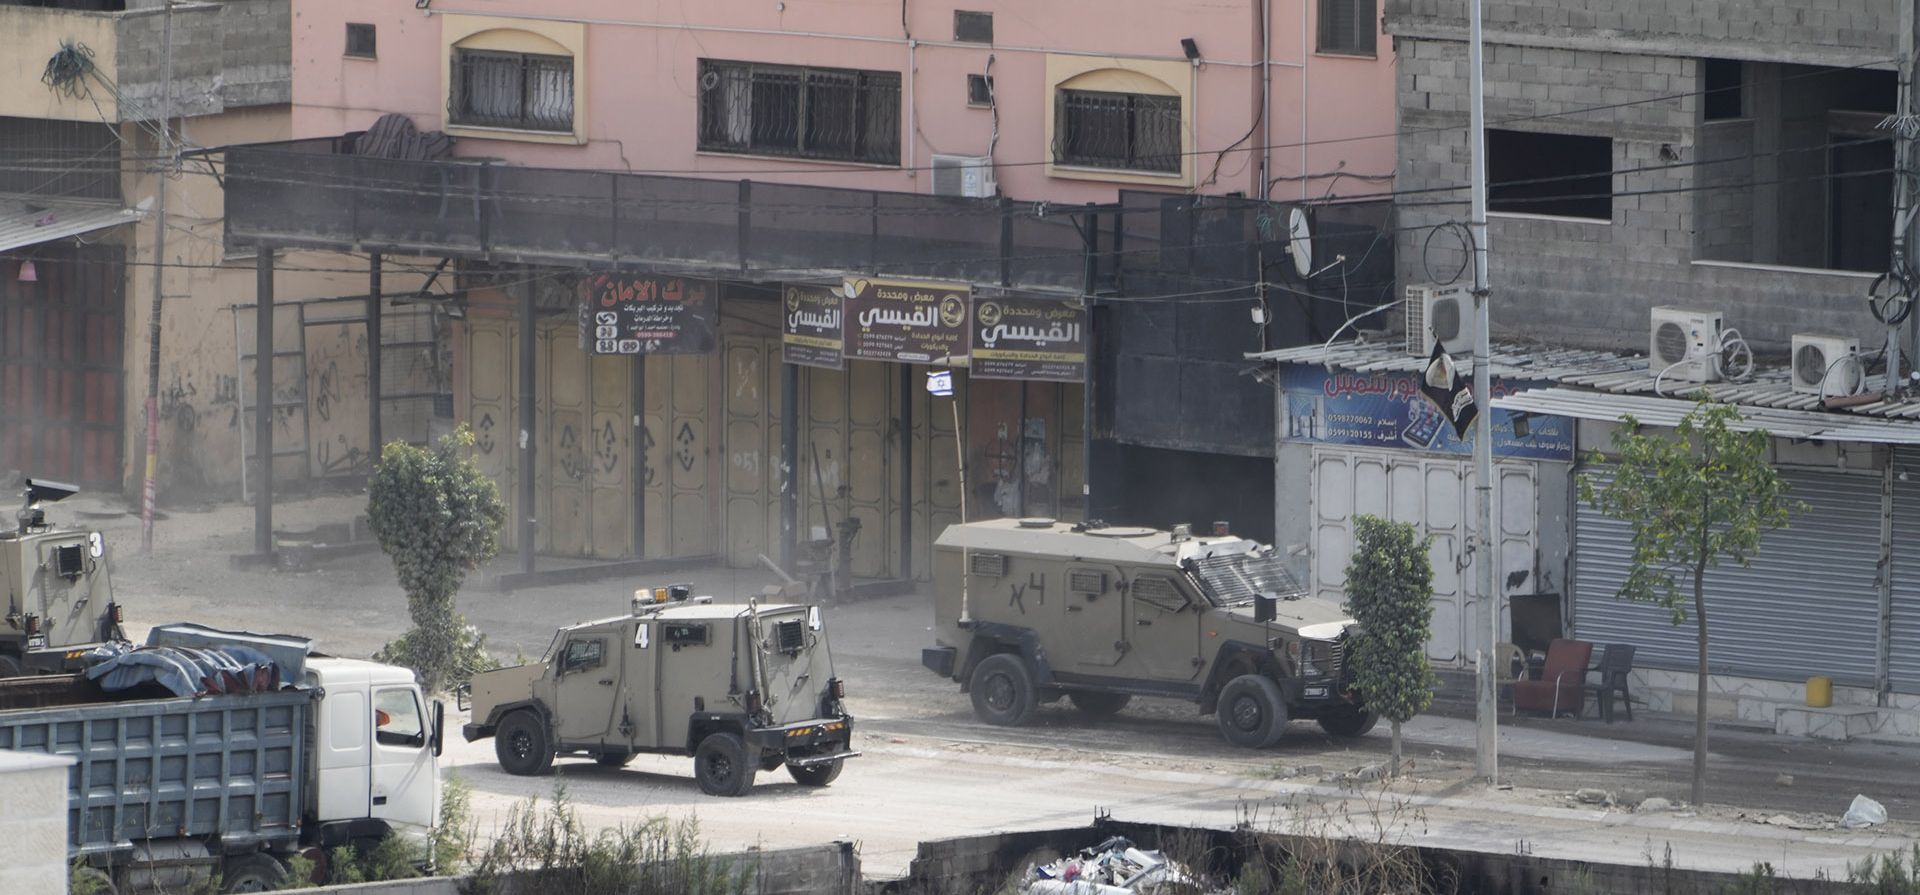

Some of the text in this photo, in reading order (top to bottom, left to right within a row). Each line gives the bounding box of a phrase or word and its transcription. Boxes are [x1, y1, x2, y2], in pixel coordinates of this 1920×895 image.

[600, 279, 657, 306] الامان
[877, 289, 935, 303] معرض ومحددة
[788, 308, 840, 333] القيسي
[859, 305, 938, 333] القيسي
[1003, 305, 1041, 318] ومحددة
[981, 322, 1080, 348] القيسي
[1377, 430, 1397, 441] أشرف
[89, 532, 102, 557] 3
[809, 606, 821, 631] 4
[635, 623, 649, 649] 4
